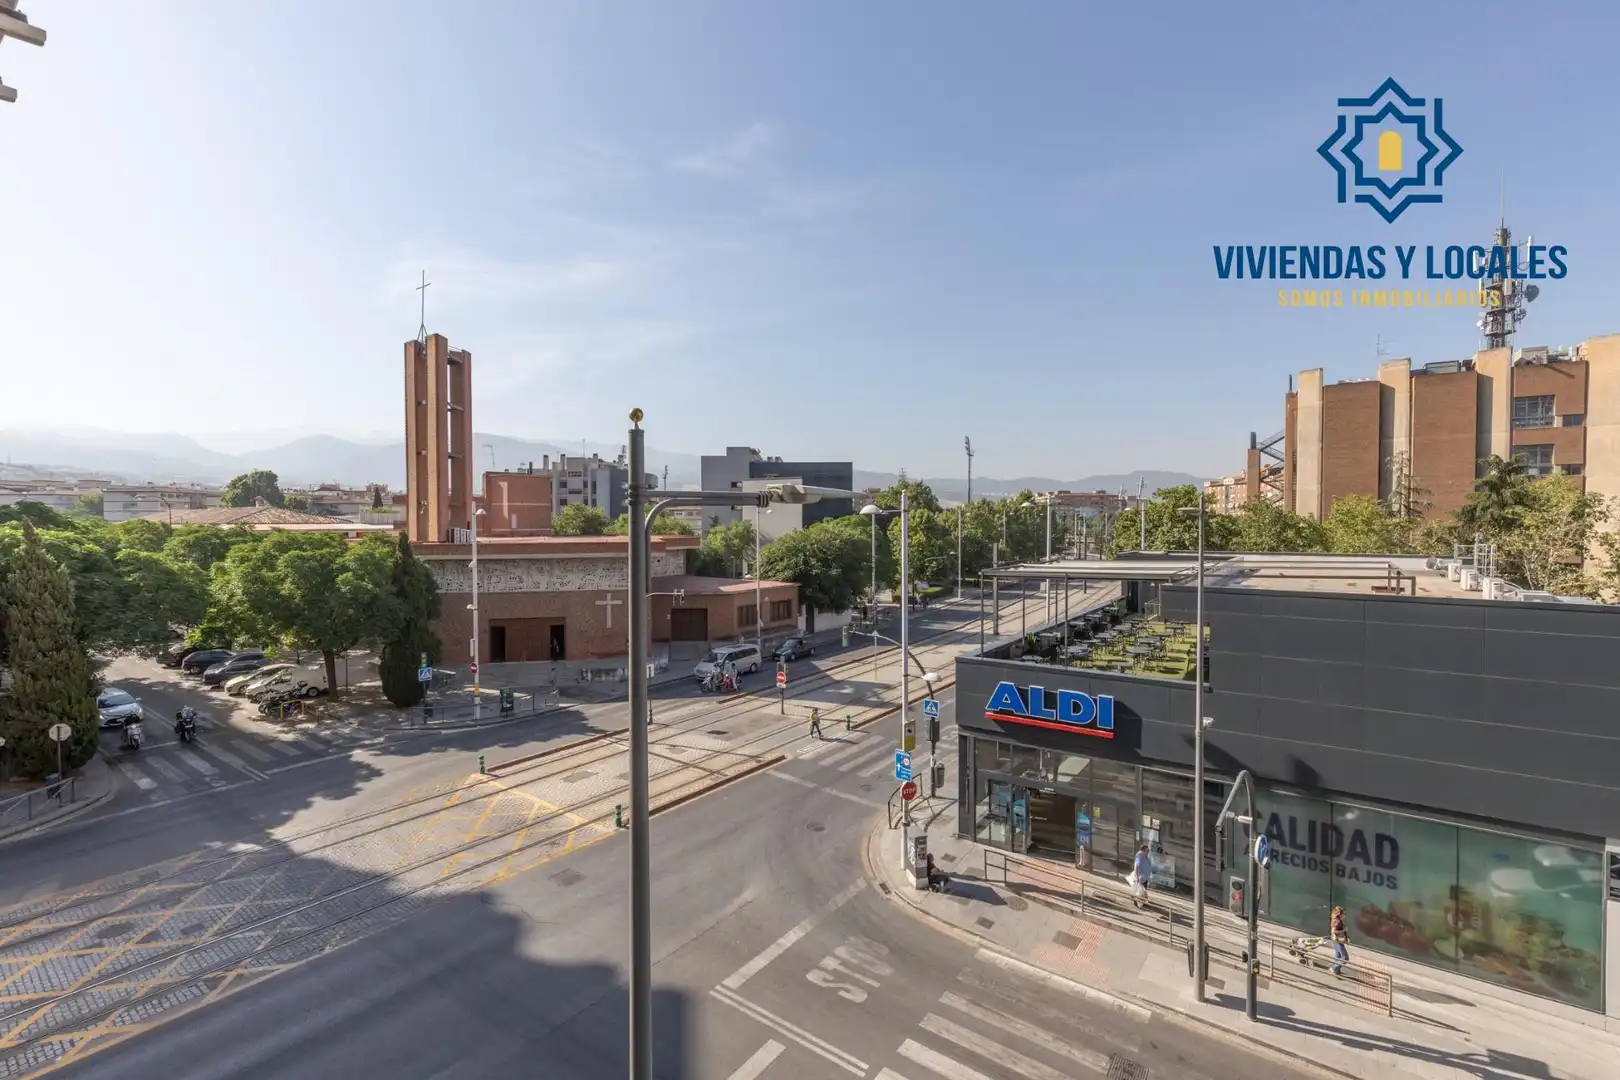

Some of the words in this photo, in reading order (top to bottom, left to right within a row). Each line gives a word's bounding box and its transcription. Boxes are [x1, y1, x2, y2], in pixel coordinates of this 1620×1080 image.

[985, 681, 1115, 729] ALDI
[903, 786, 916, 795] STOP
[1335, 863, 1398, 890] BAJOS
